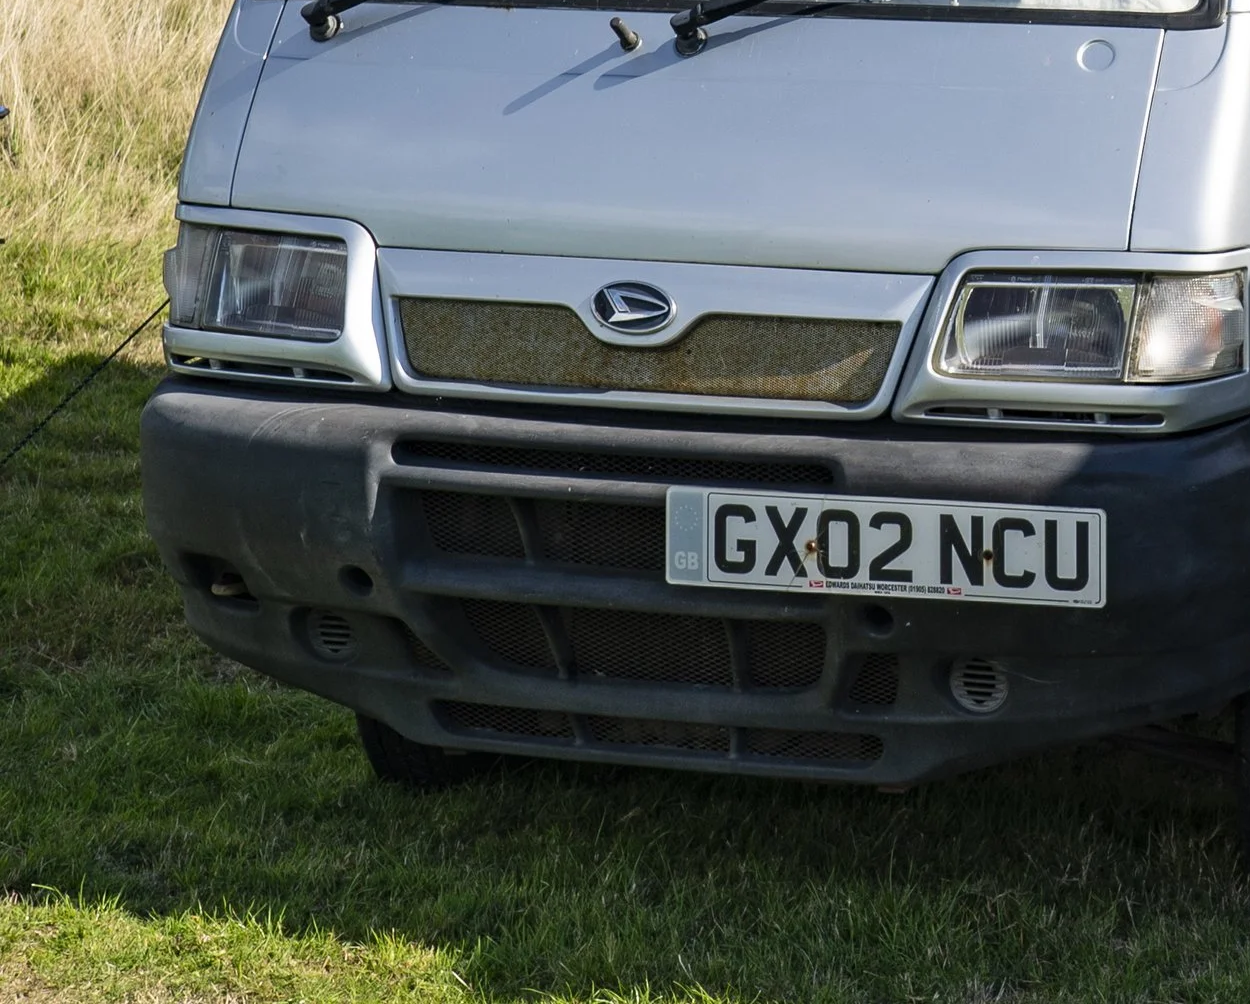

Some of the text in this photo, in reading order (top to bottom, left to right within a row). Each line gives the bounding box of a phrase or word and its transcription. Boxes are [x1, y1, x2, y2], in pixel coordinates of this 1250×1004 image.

[714, 503, 1089, 592] GX02 NCU
[674, 550, 699, 570] GB
[825, 581, 849, 589] EDWARDS
[851, 582, 875, 590] DAIHATSU
[876, 583, 907, 593] WORCESTER
